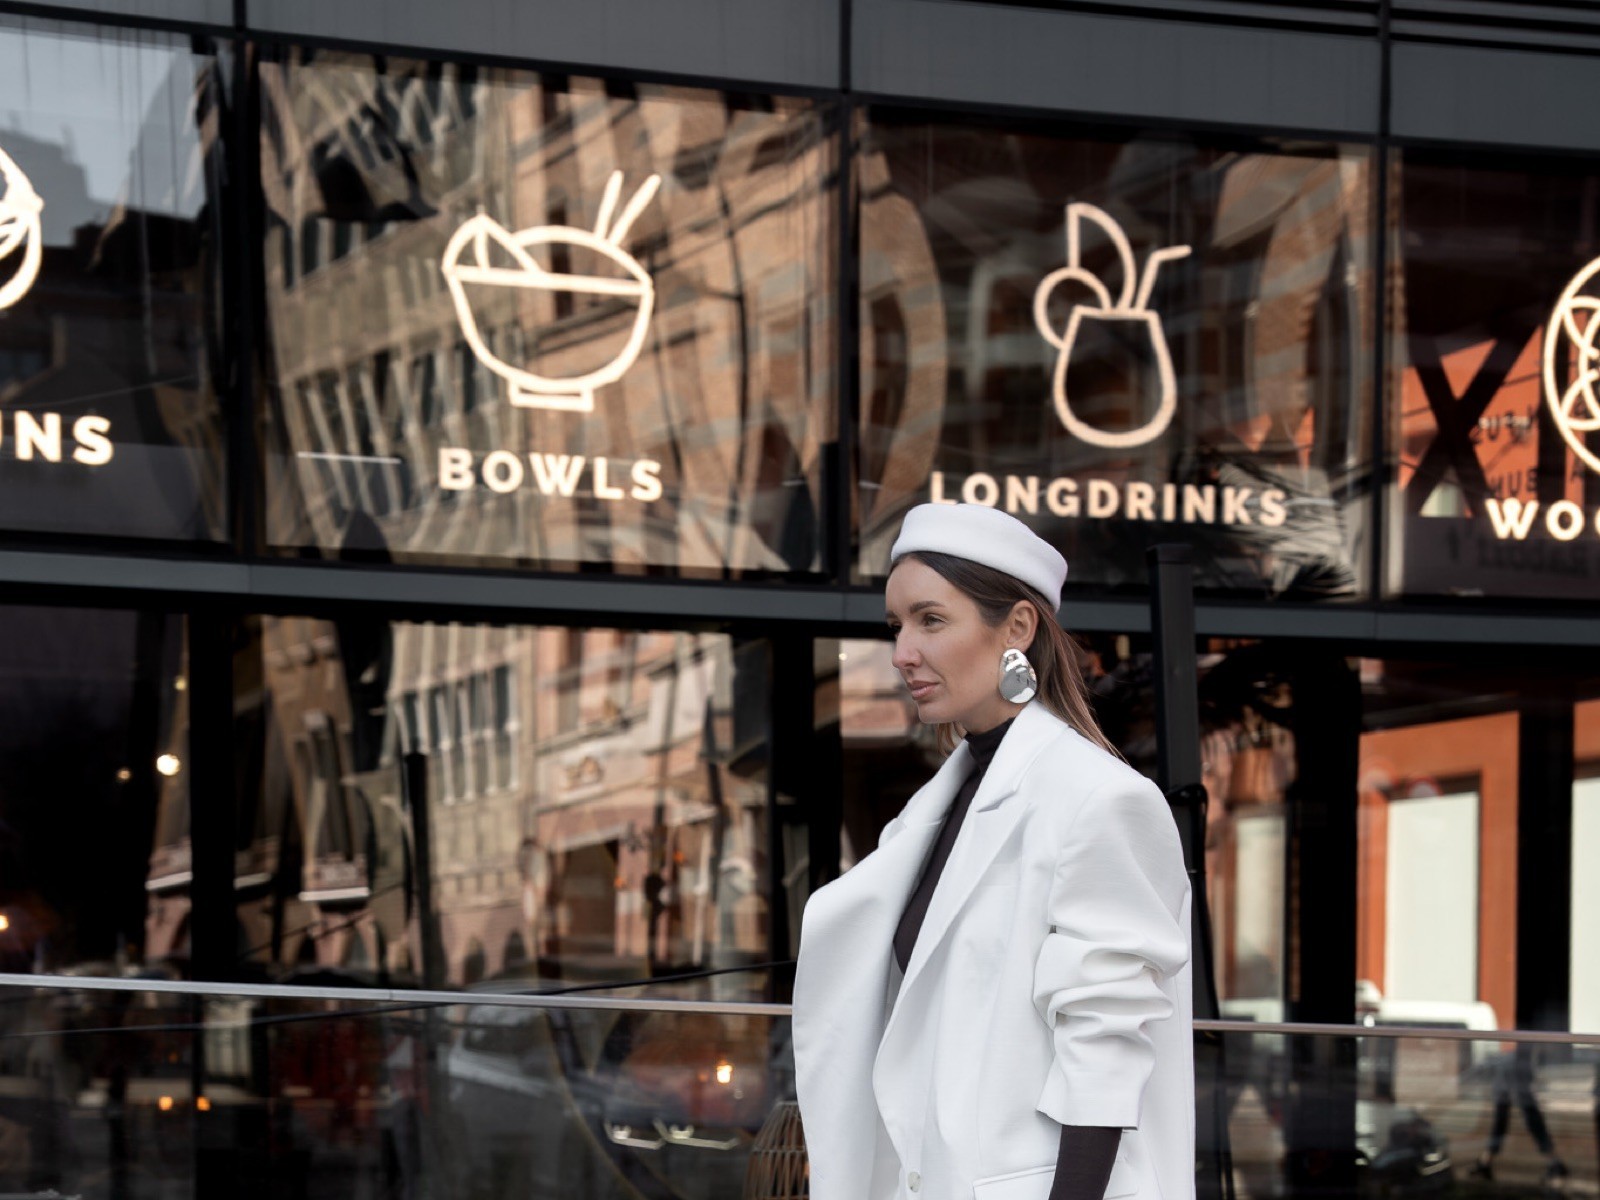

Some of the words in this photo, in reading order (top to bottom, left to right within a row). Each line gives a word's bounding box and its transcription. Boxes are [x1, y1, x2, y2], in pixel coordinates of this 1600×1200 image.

[0, 409, 114, 466] NS
[438, 447, 663, 502] BOWLS
[930, 471, 1287, 527] LONGDRINKS
[1485, 497, 1600, 541] WO
